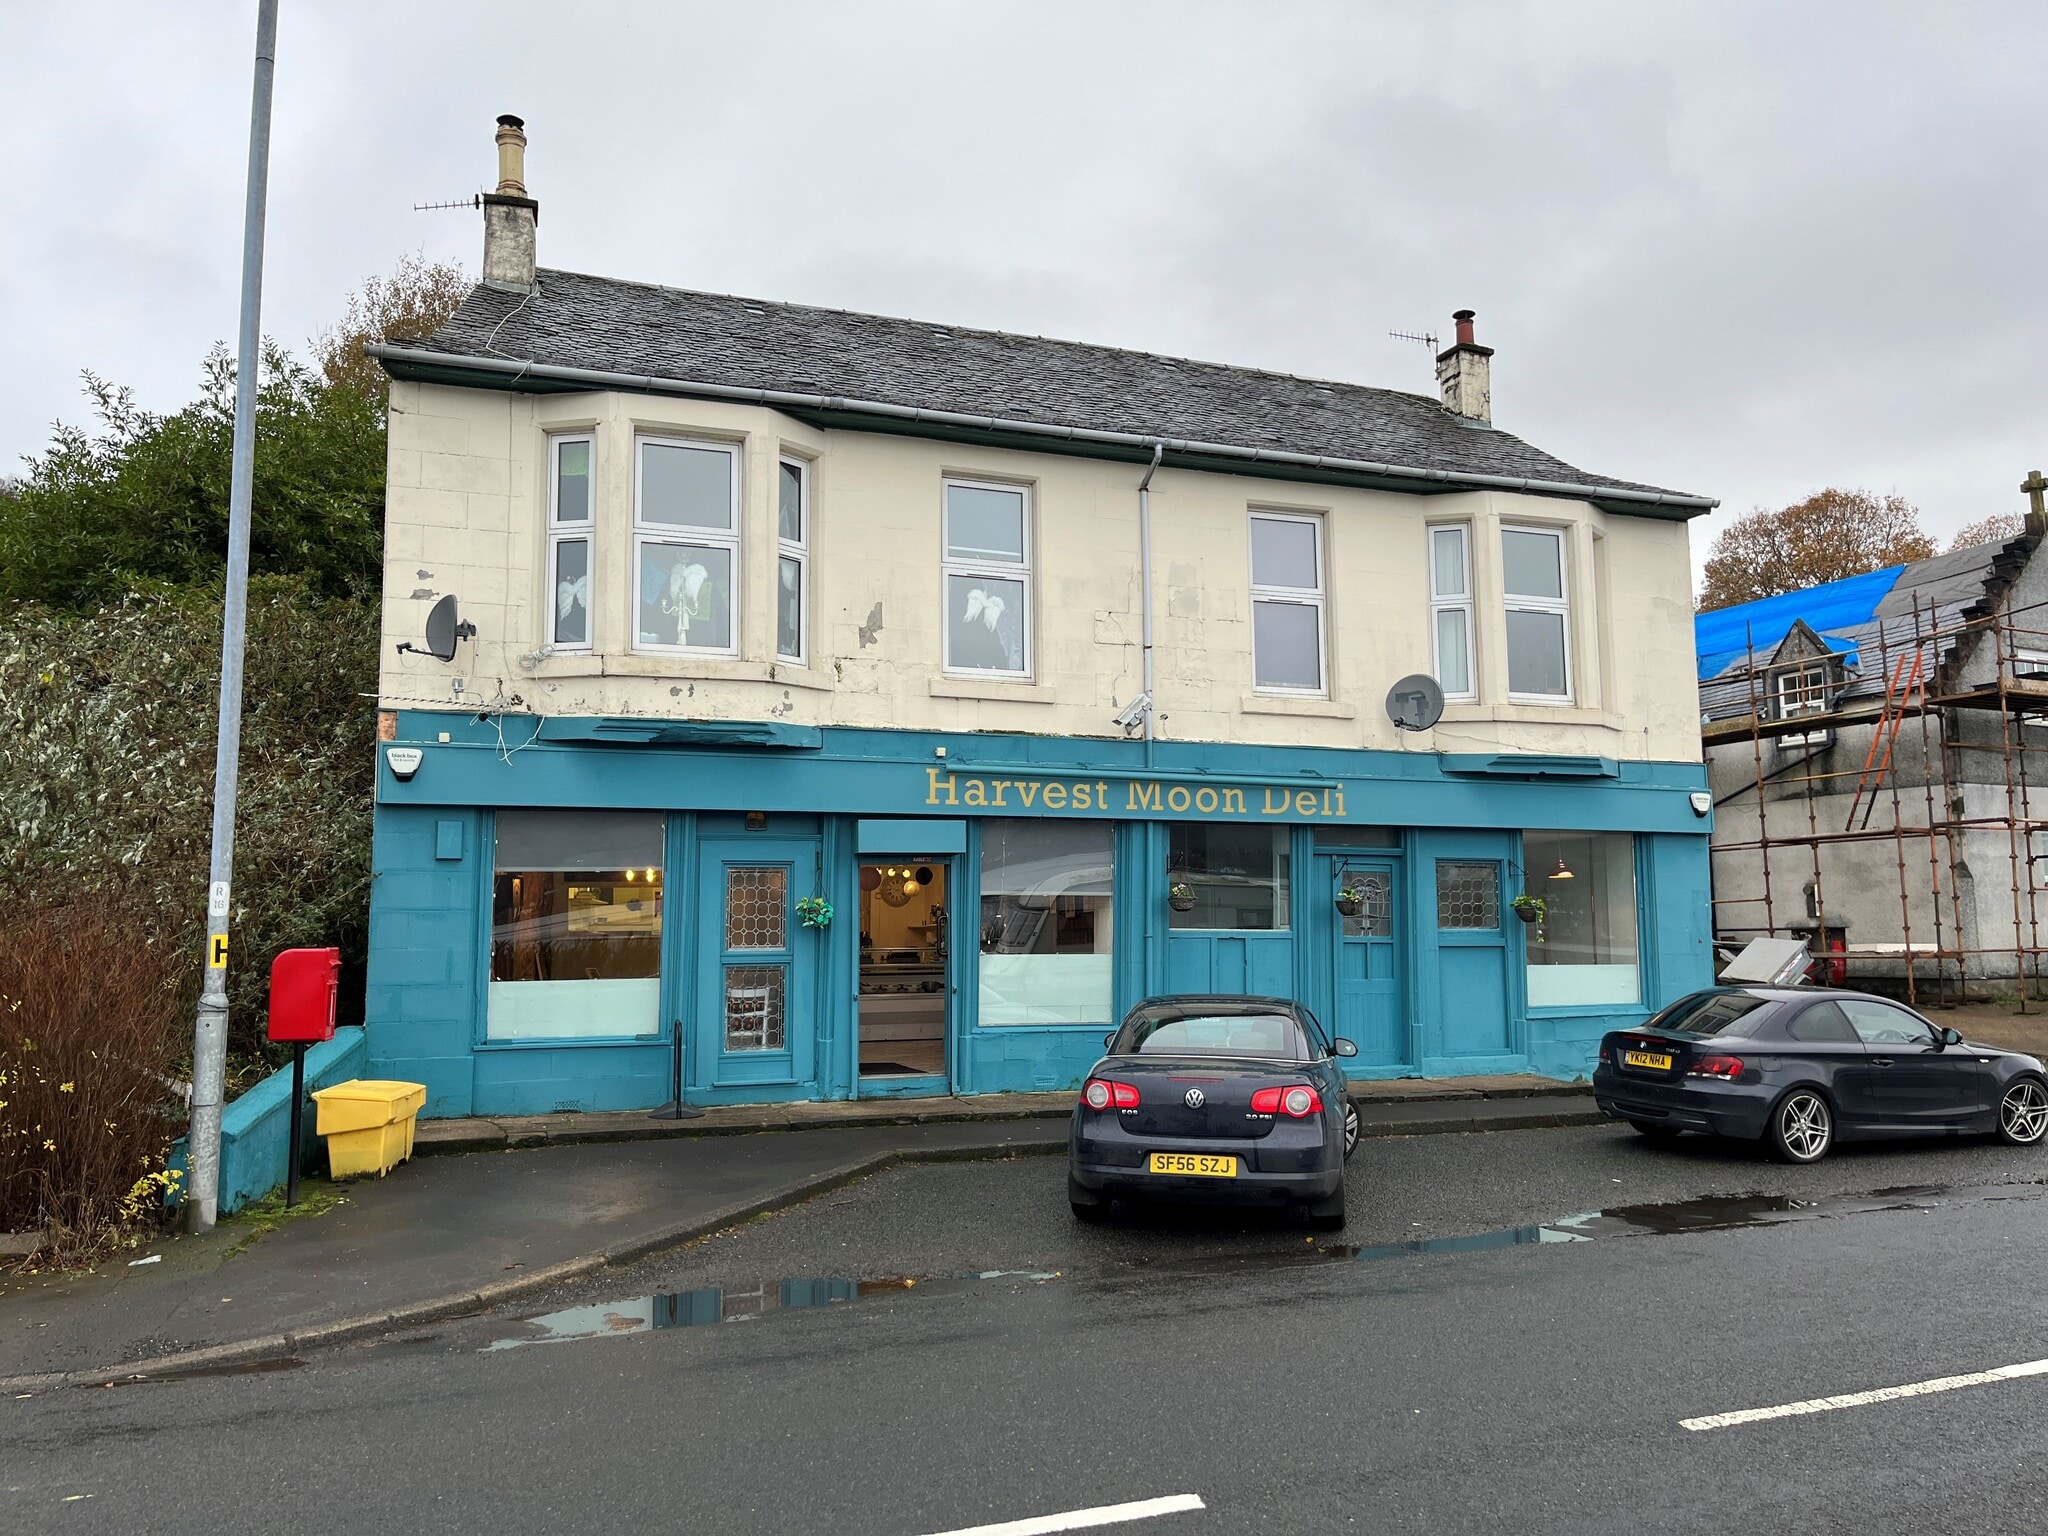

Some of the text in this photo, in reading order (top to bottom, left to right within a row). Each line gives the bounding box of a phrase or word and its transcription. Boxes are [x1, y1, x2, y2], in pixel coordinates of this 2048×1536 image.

[926, 769, 1346, 817] Harvest Moon Deli
[216, 887, 223, 896] R
[1629, 1052, 1665, 1067] YK12 NHA
[1156, 1155, 1230, 1173] SF56 SZJ
